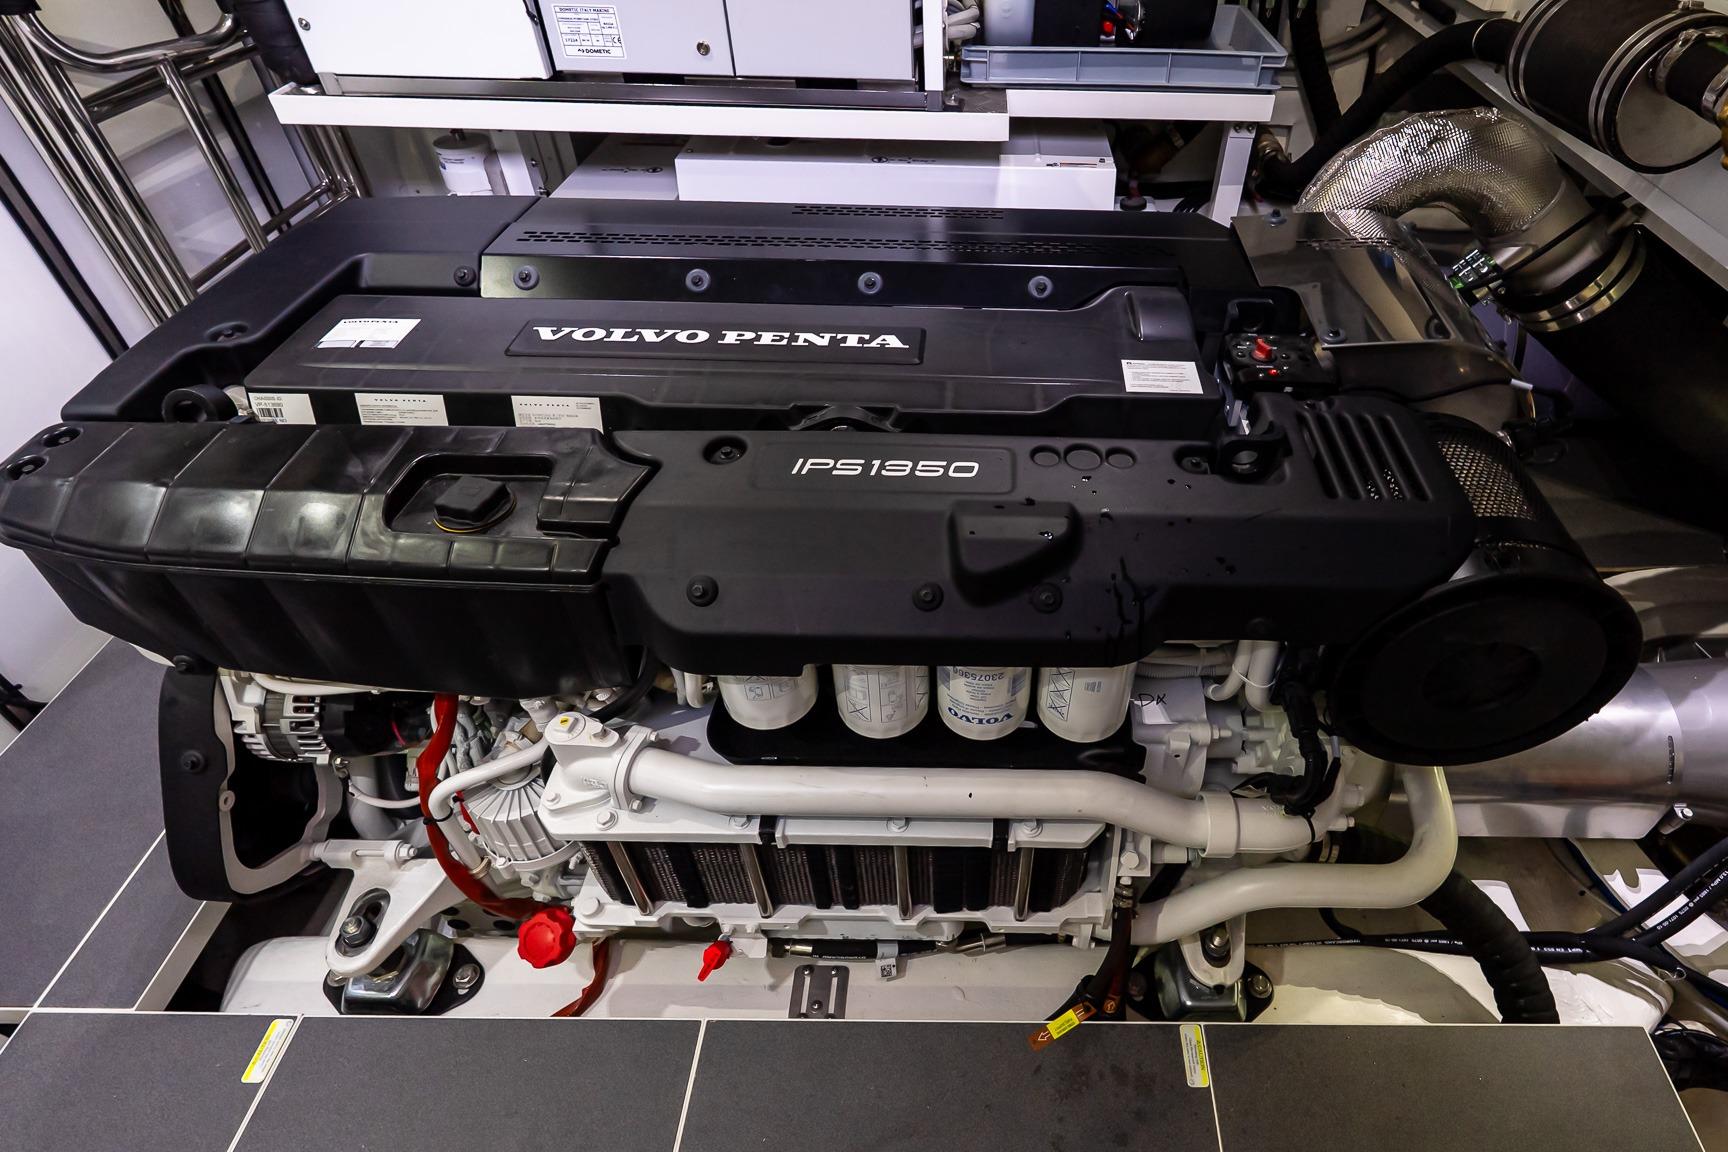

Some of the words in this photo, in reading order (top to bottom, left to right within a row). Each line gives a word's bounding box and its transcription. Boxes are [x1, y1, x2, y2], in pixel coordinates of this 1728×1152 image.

[533, 326, 710, 344] VOLVO
[717, 330, 909, 349] PENTA
[791, 458, 980, 478] IPS1350
[947, 706, 1014, 724] VOLVO
